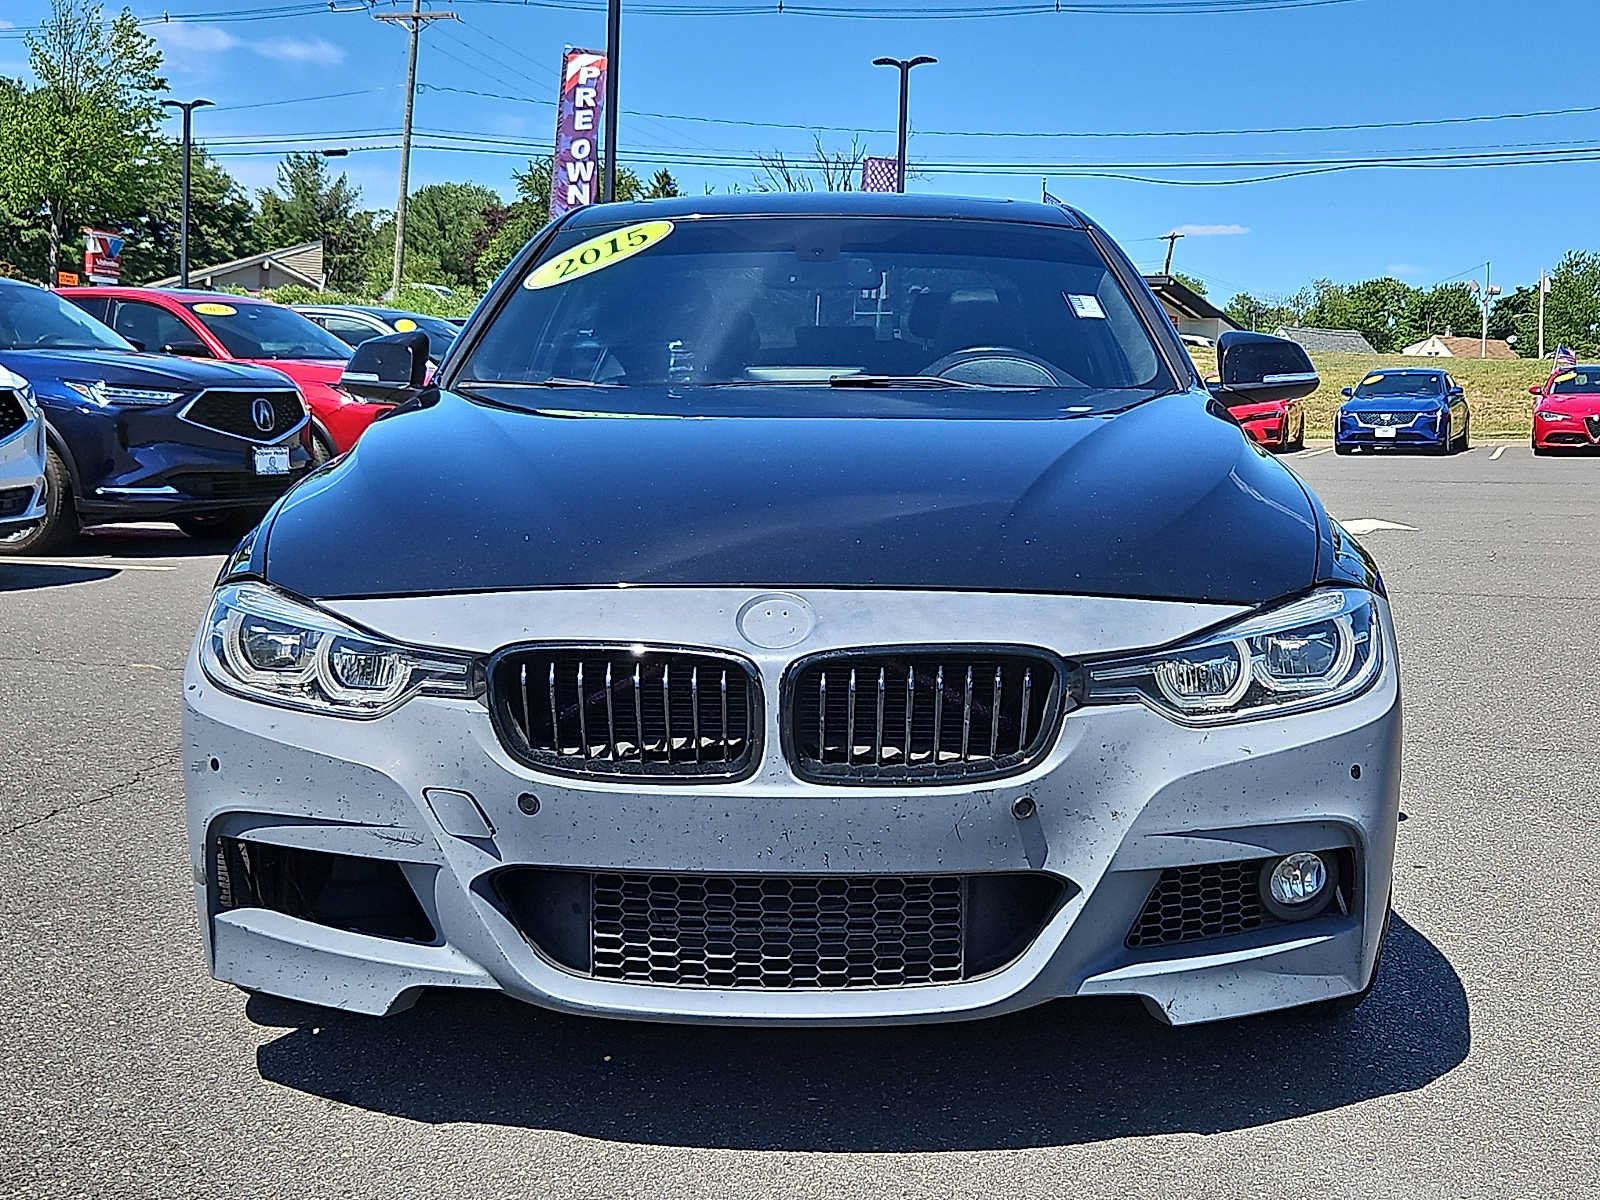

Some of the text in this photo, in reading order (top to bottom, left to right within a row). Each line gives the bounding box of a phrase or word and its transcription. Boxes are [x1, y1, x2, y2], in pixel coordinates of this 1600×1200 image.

[566, 65, 601, 206] PRE OWN
[555, 227, 649, 279] 2015
